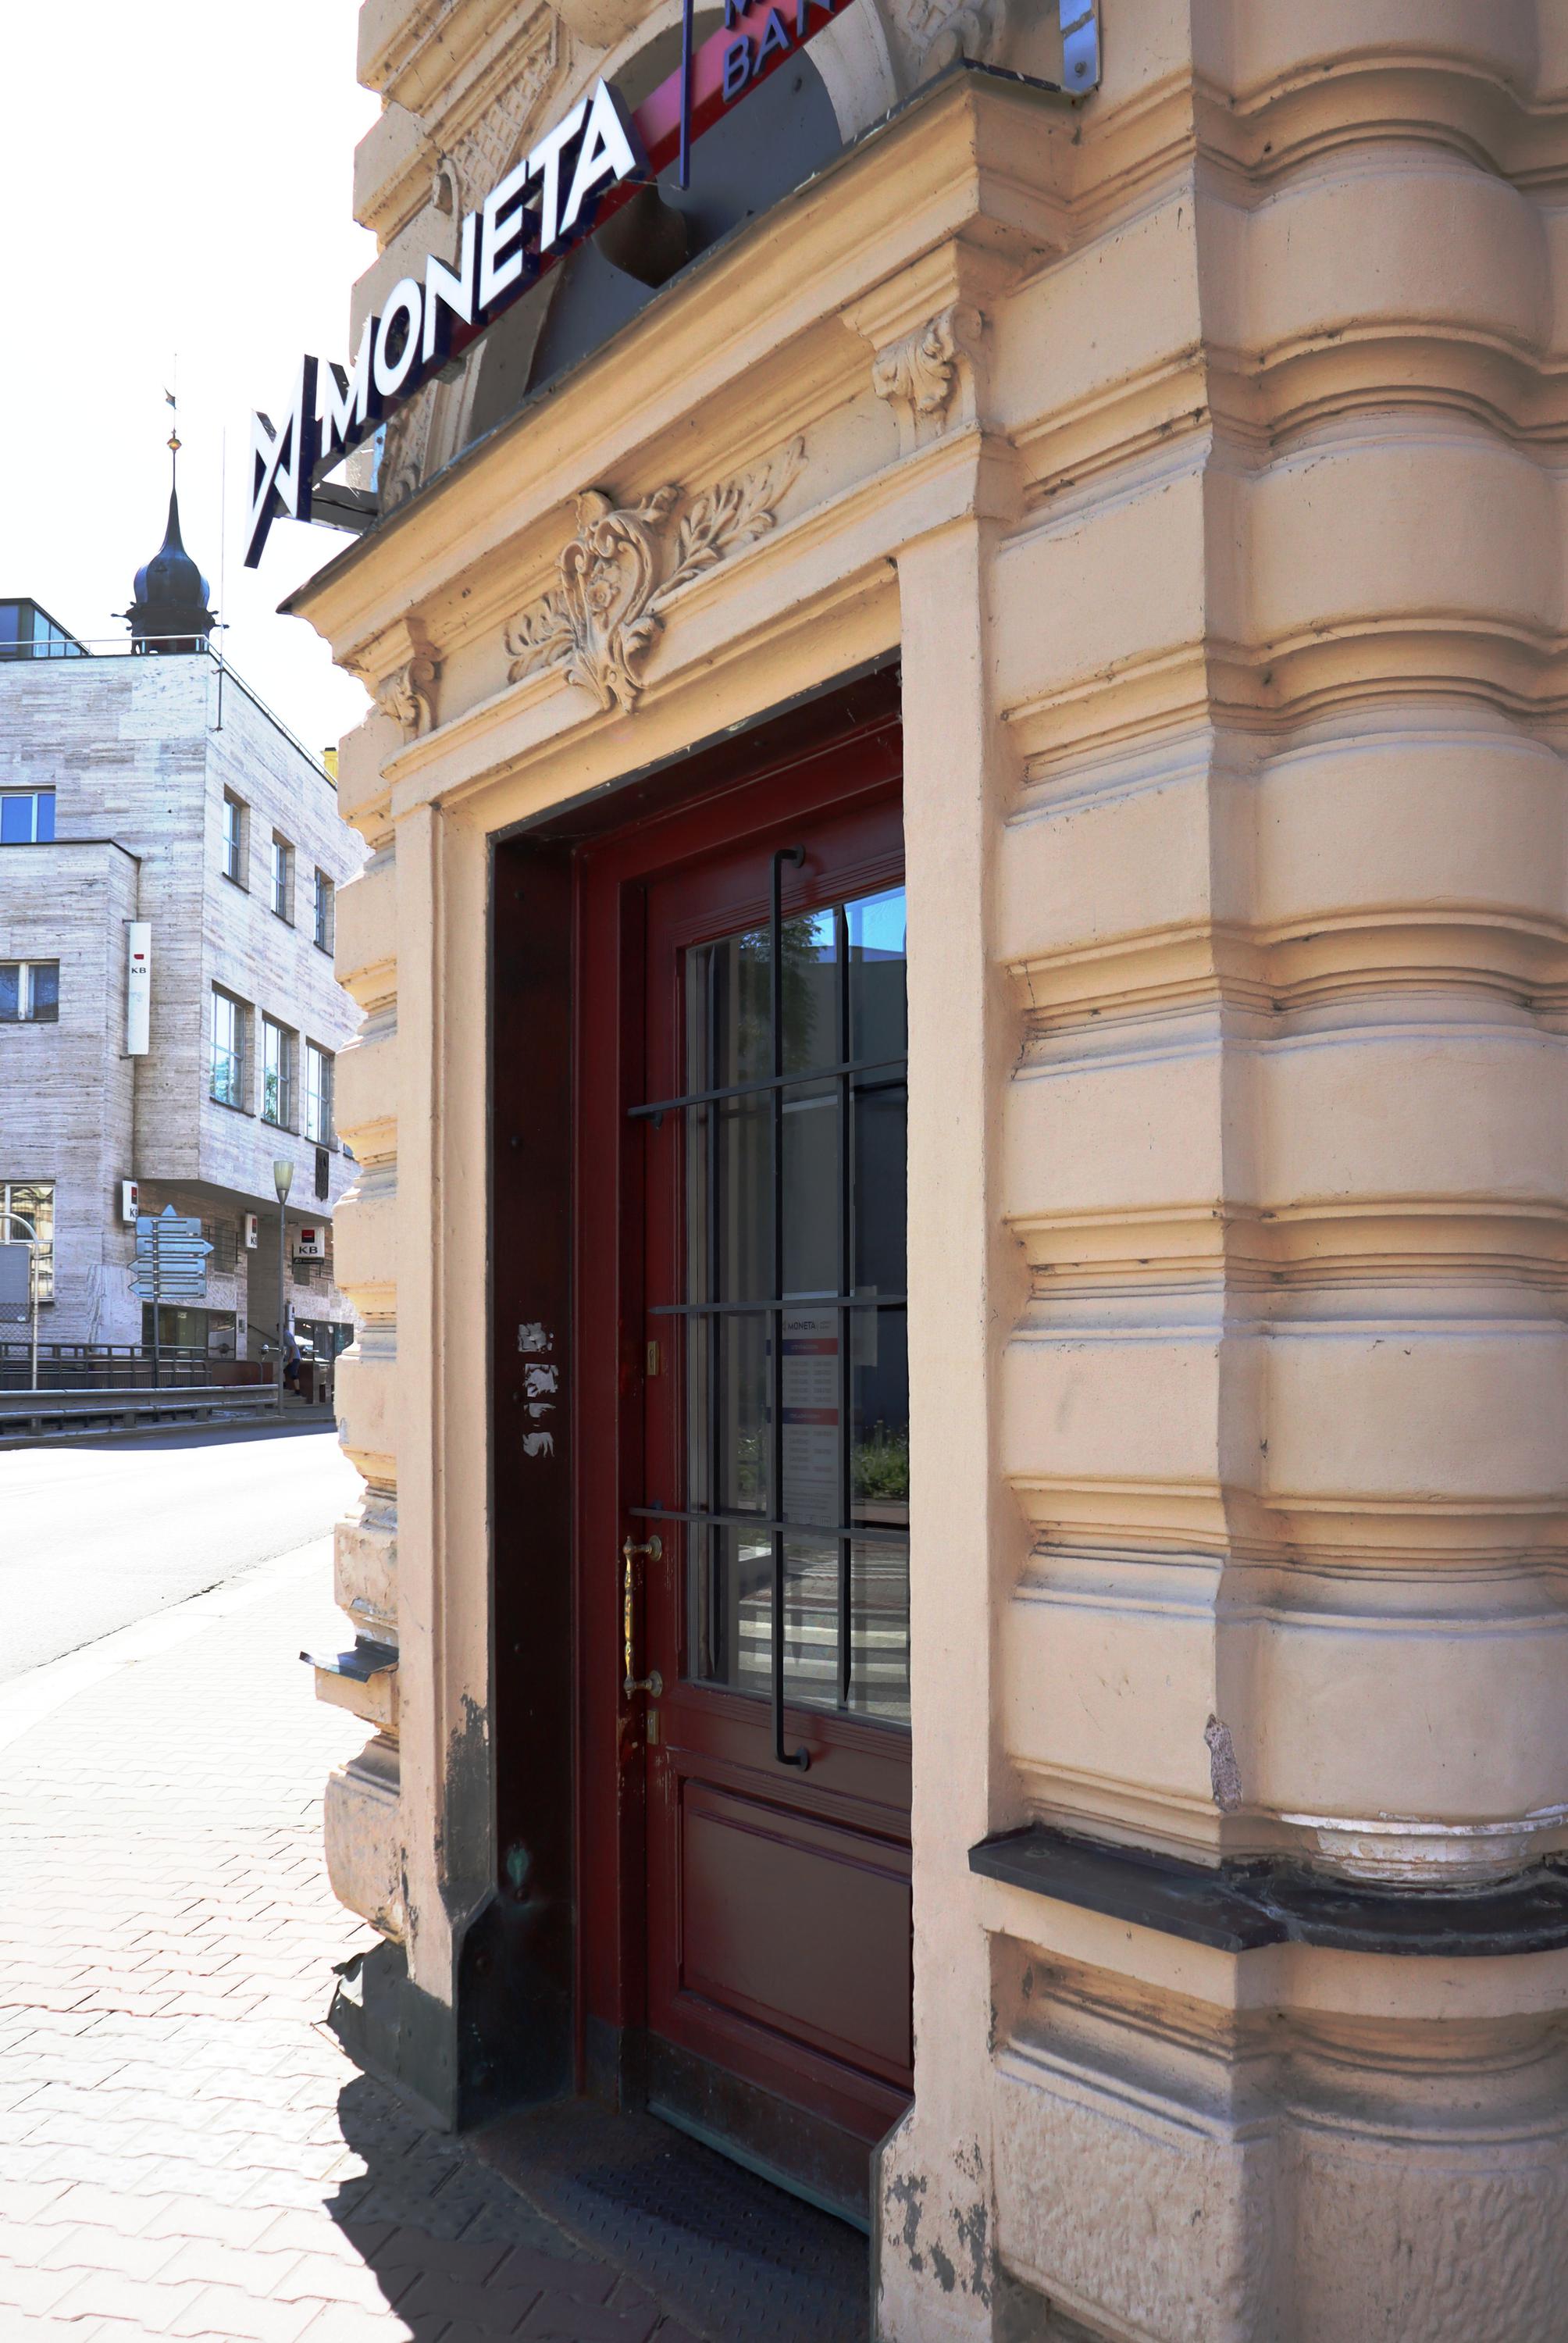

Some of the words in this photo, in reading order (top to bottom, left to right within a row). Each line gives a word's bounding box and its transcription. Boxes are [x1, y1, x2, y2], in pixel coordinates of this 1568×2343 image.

[320, 77, 639, 459] MONETA
[299, 1246, 318, 1254] KB
[788, 1321, 816, 1331] MONETA
